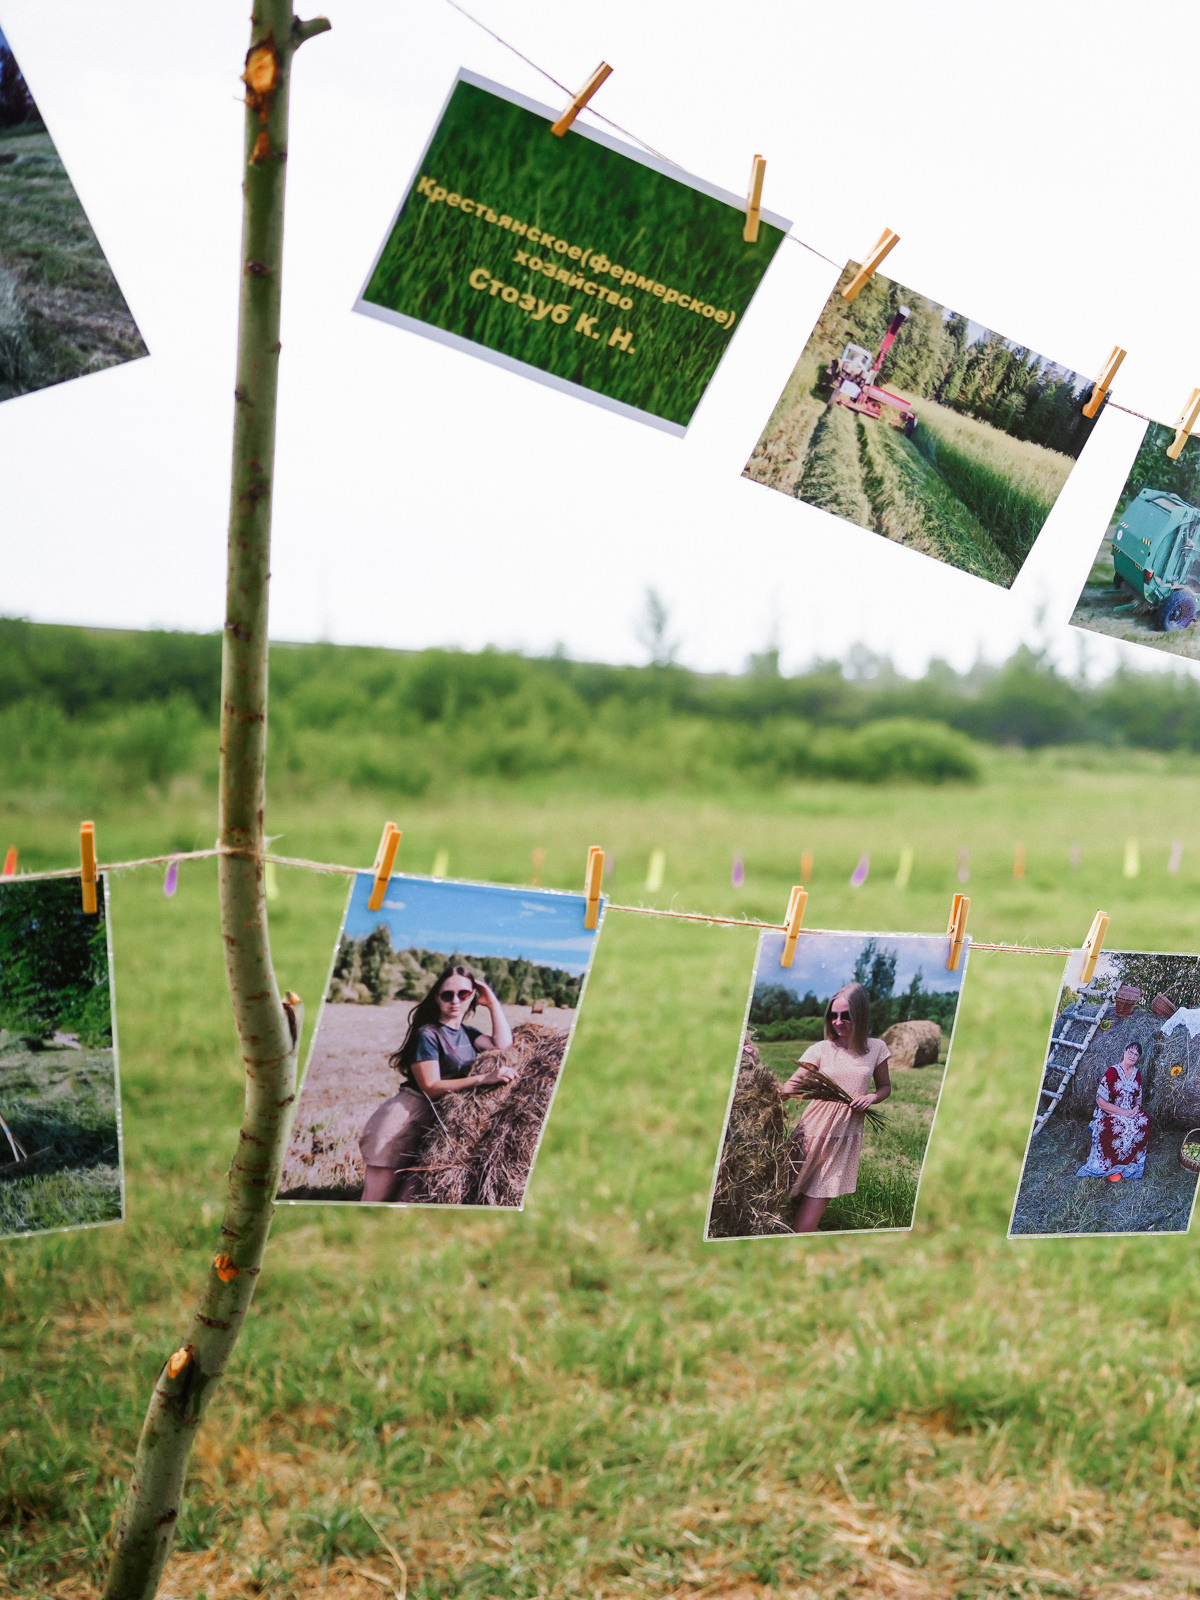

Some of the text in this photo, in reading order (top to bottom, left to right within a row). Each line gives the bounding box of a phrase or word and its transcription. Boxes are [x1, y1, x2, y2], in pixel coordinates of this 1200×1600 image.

[468, 268, 636, 355] Стозуб К. Н.
[512, 249, 634, 311] хозяйство
